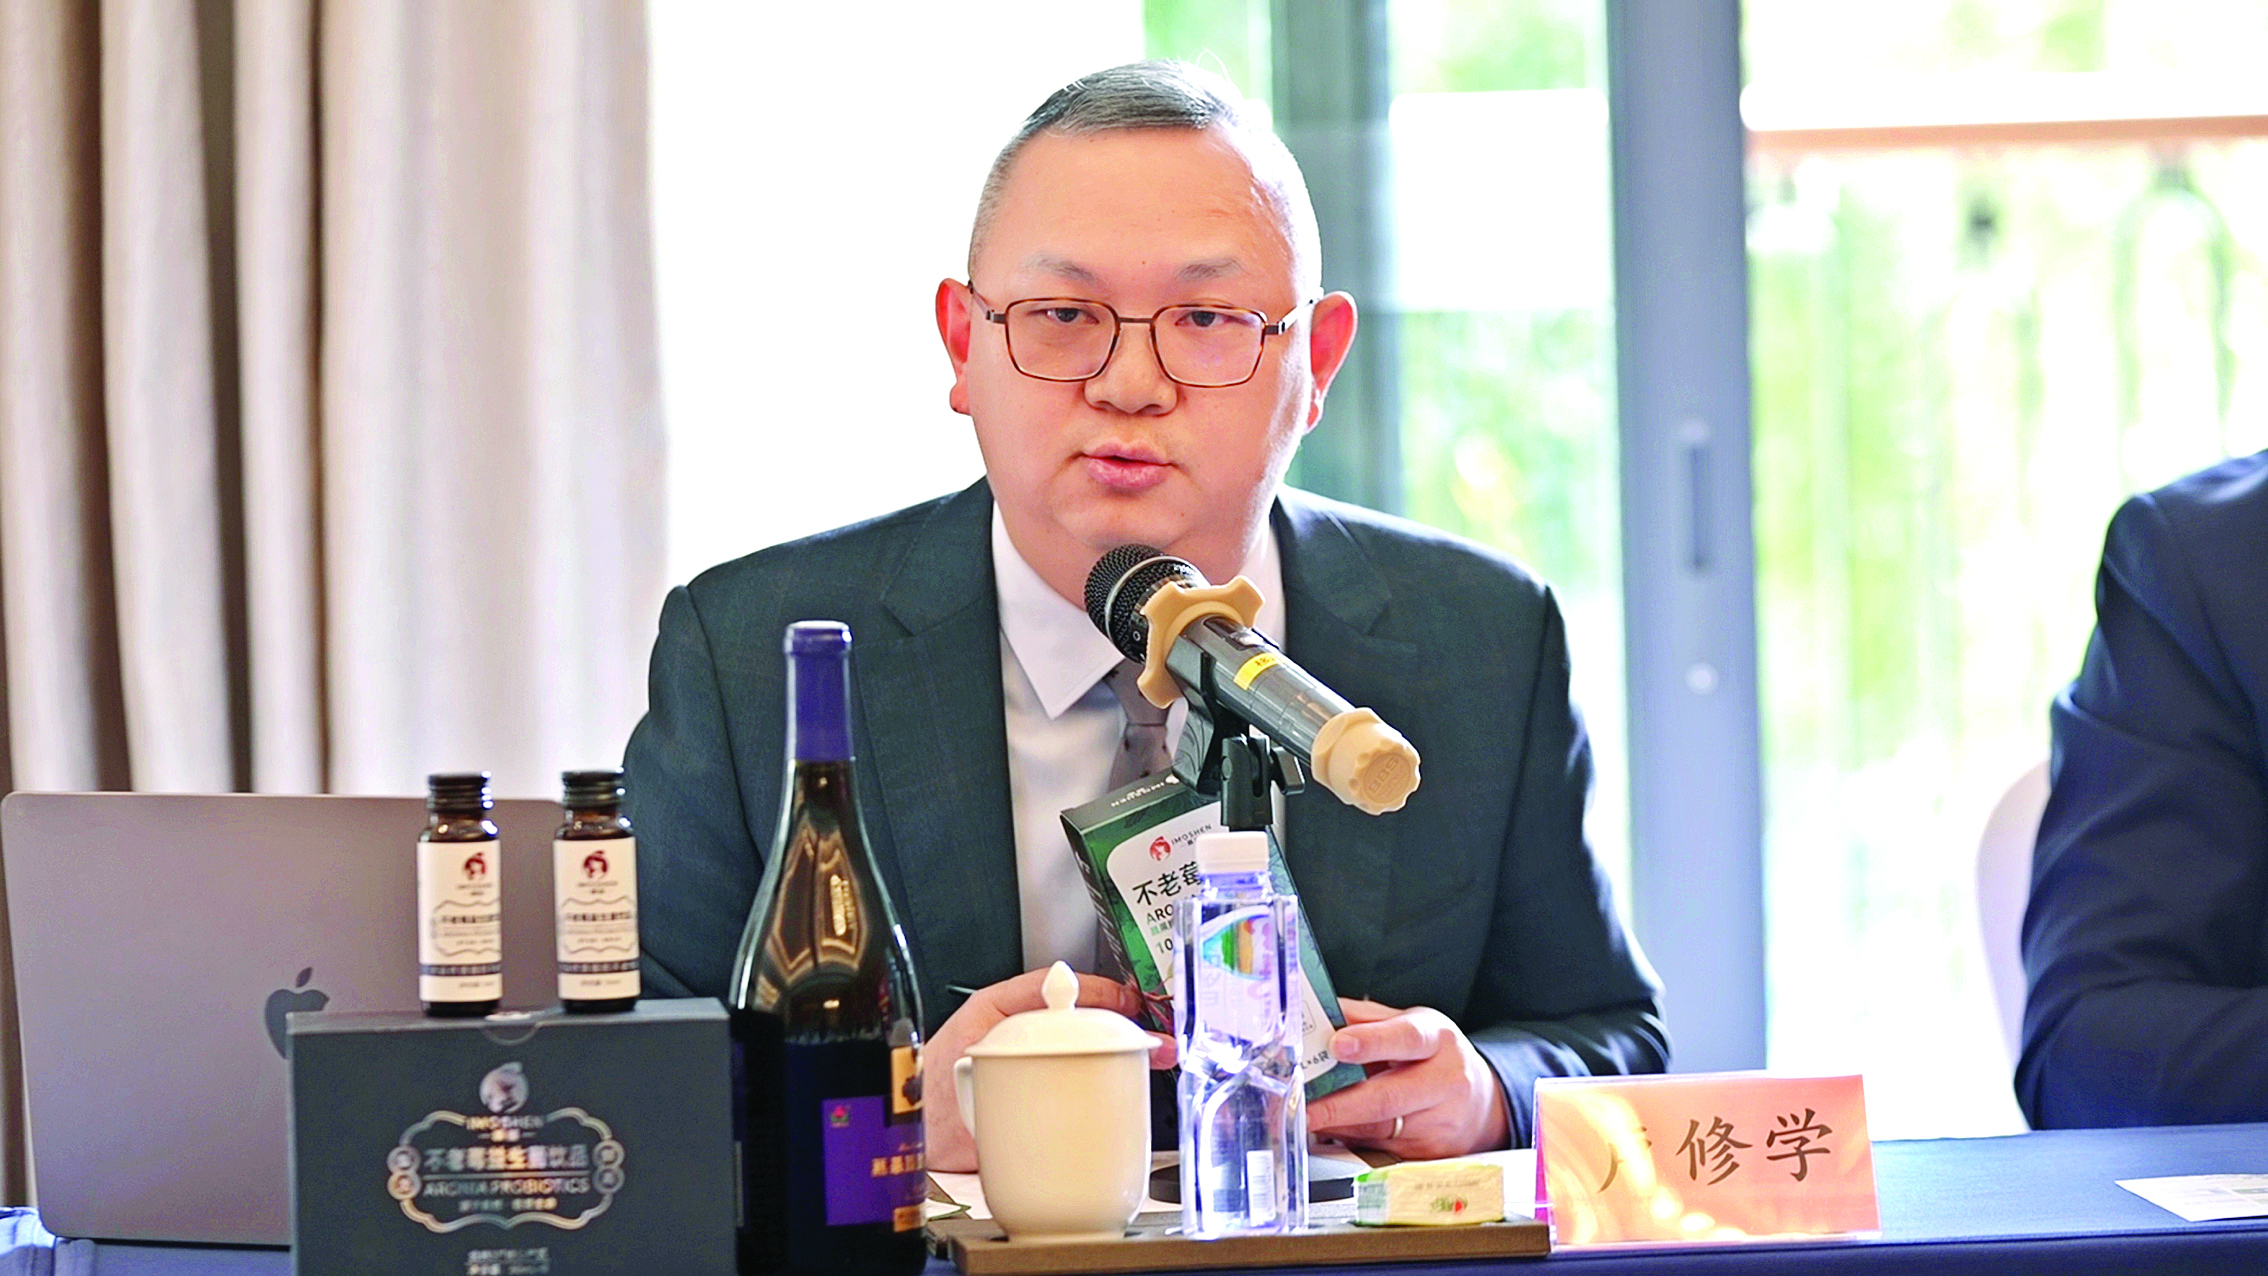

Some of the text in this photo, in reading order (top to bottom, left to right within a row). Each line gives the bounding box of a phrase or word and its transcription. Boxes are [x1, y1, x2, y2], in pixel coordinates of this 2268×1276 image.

[1368, 757, 1400, 793] BBS
[1171, 823, 1212, 846] IMOSHEN
[1132, 861, 1200, 906] 不老莓
[1155, 938, 1174, 954] 10
